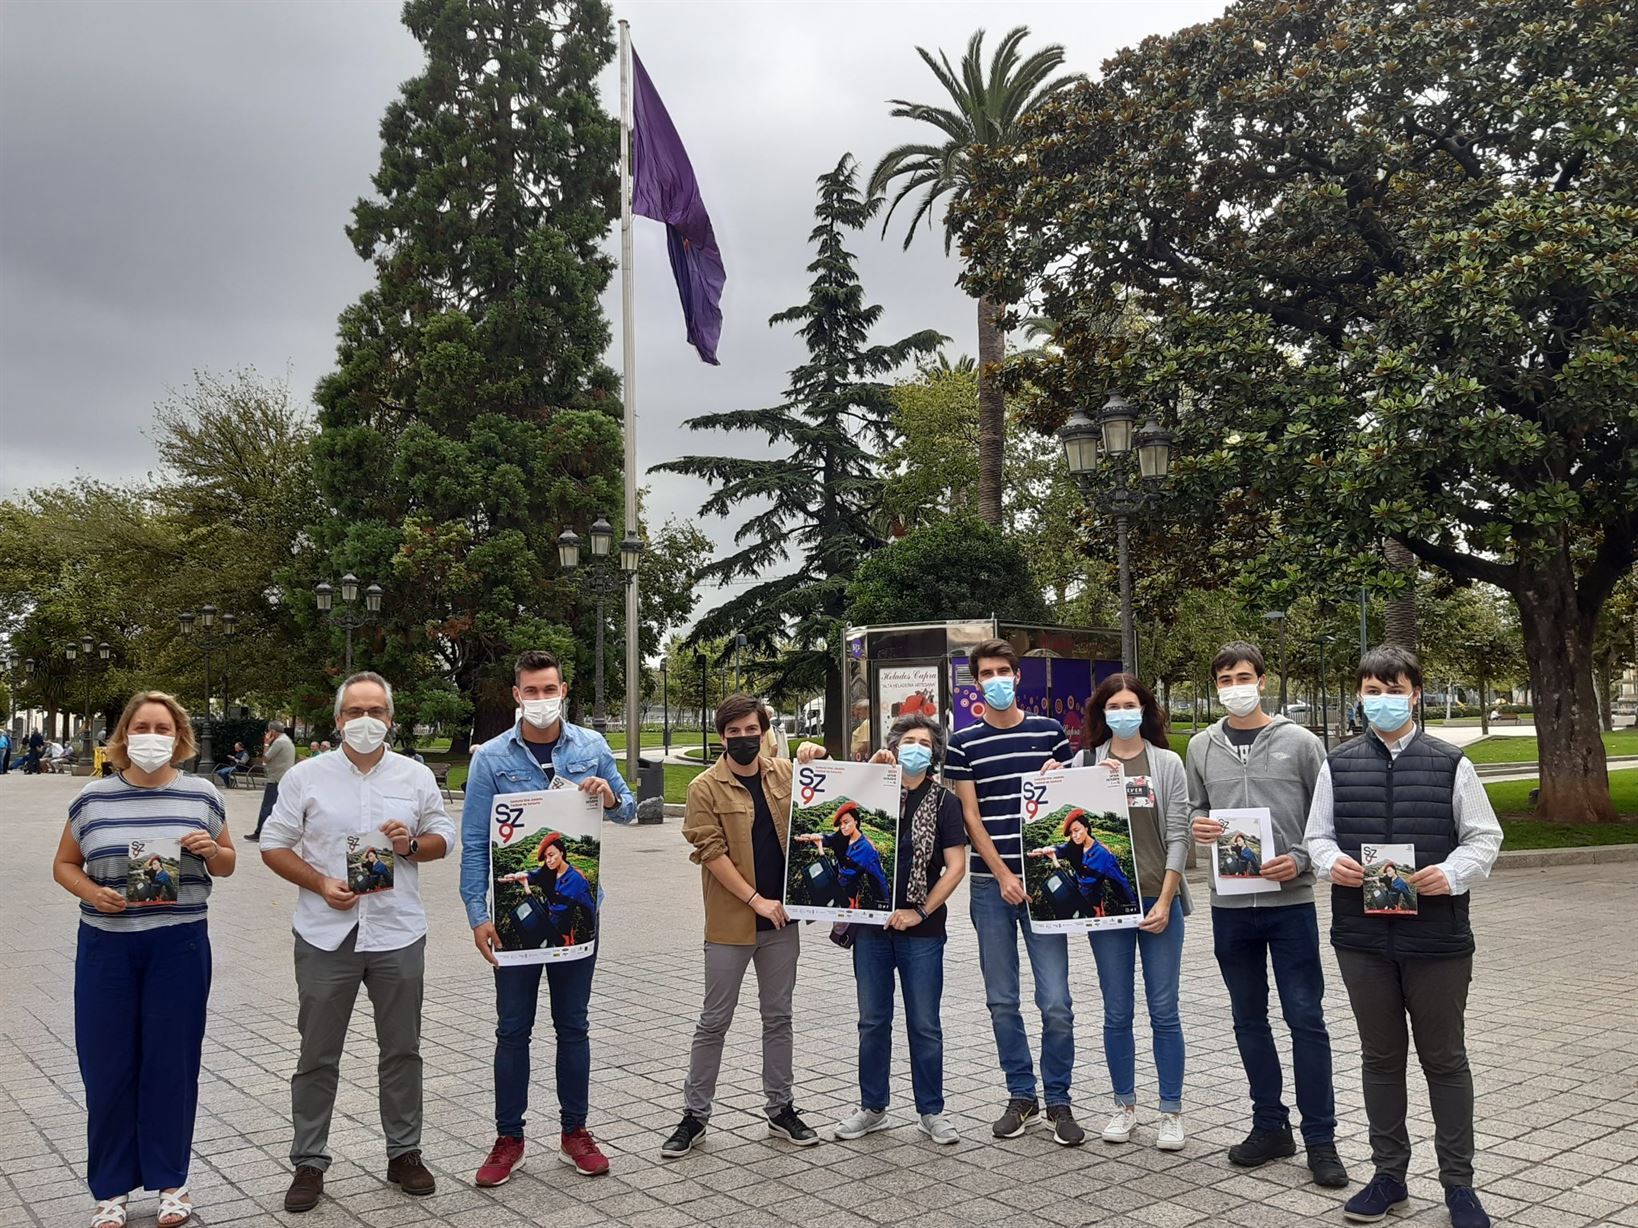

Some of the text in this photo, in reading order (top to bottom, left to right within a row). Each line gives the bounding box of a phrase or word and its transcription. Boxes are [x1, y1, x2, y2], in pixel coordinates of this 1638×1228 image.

[881, 670, 937, 682] Helados Capra
[799, 767, 827, 793] SZ
[801, 786, 815, 805] 9
[1023, 781, 1049, 805] SZ
[495, 803, 525, 828] SZ
[1025, 800, 1038, 819] 9
[498, 822, 514, 844] 9
[131, 841, 145, 853] SZ
[1363, 846, 1378, 859] SZ
